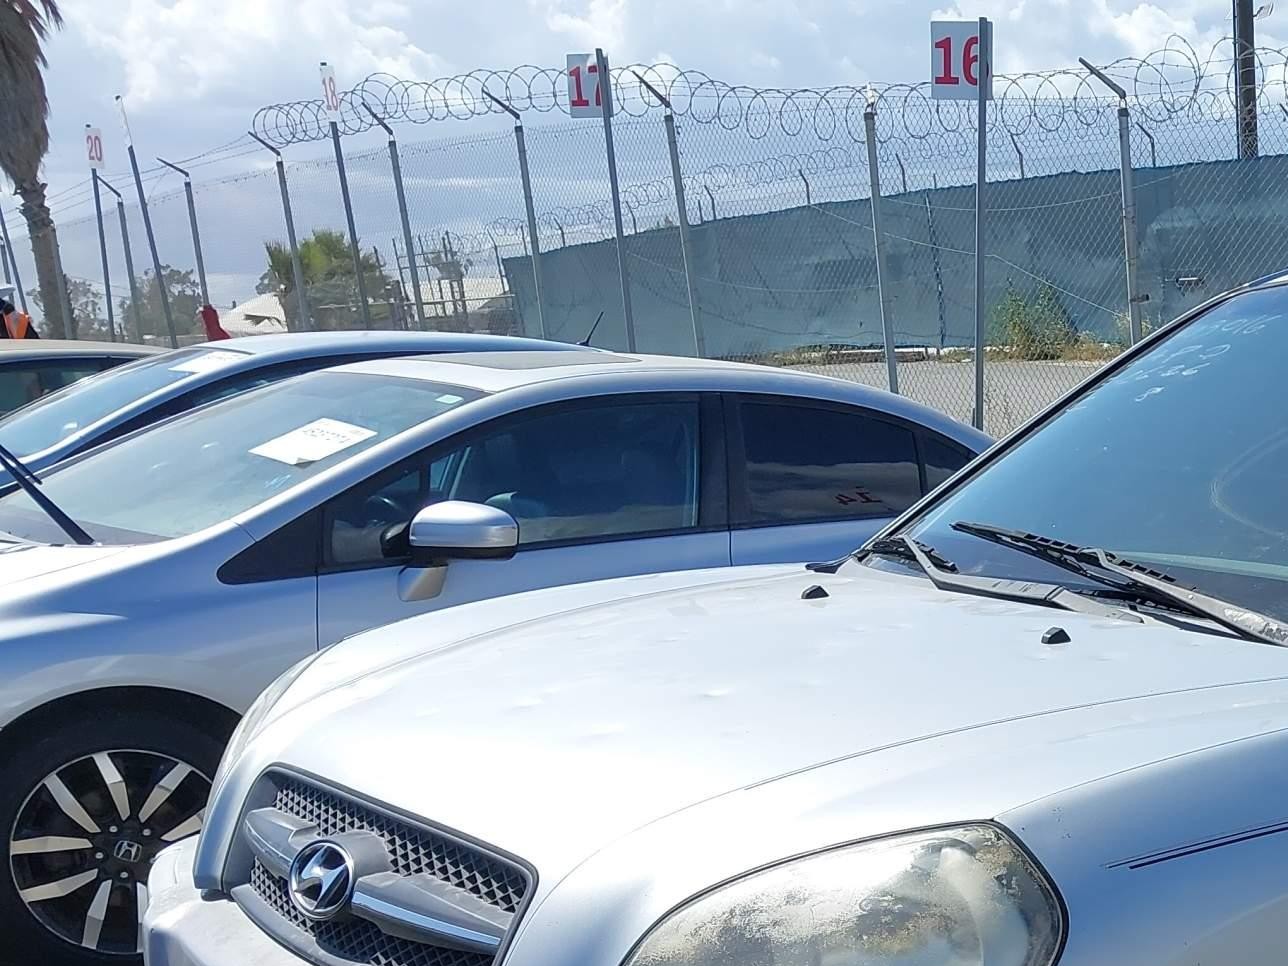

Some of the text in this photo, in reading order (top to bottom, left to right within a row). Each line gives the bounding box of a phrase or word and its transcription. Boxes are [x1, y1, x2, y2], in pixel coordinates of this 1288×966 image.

[935, 36, 989, 87] 16
[322, 77, 338, 111] 18
[86, 135, 103, 161] 20
